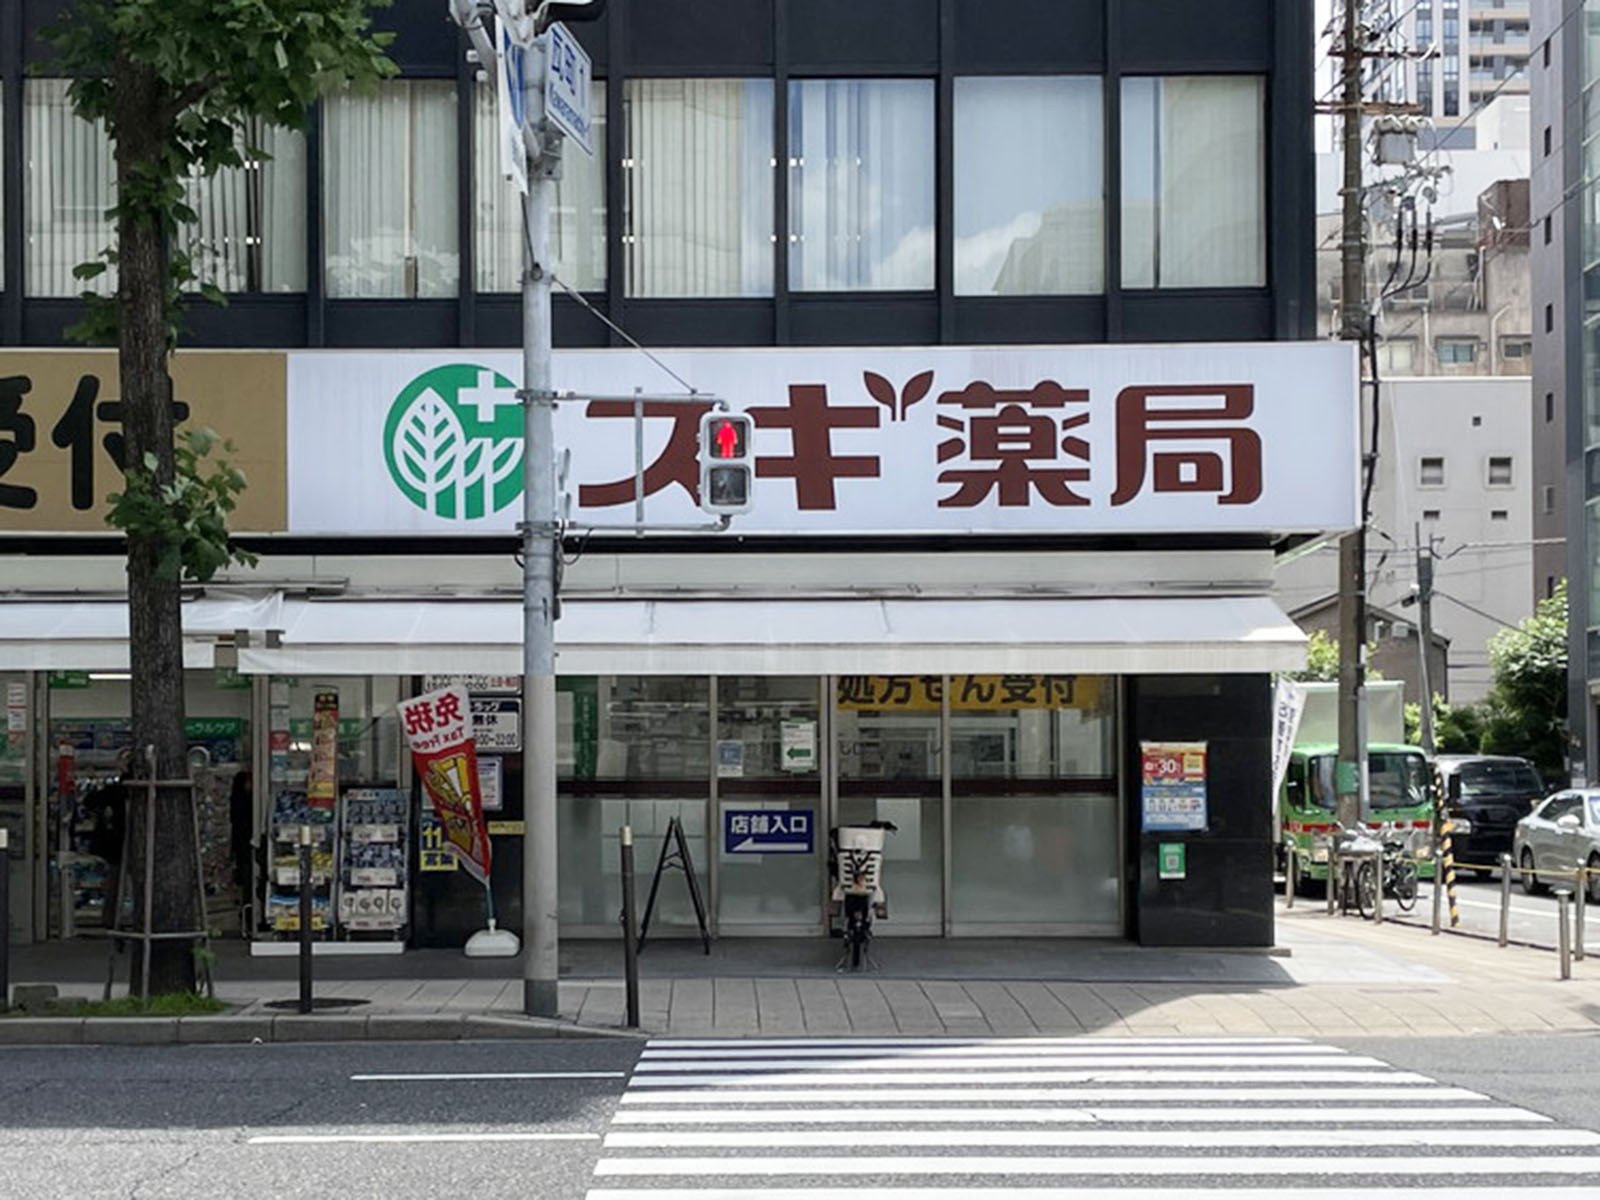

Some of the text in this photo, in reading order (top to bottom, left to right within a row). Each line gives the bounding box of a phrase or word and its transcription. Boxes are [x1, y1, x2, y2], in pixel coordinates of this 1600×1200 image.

[0, 375, 190, 510] 付
[579, 371, 1263, 509] スギ薬局
[838, 675, 1077, 704] 処方せん受付
[731, 816, 808, 834] 店舗入口
